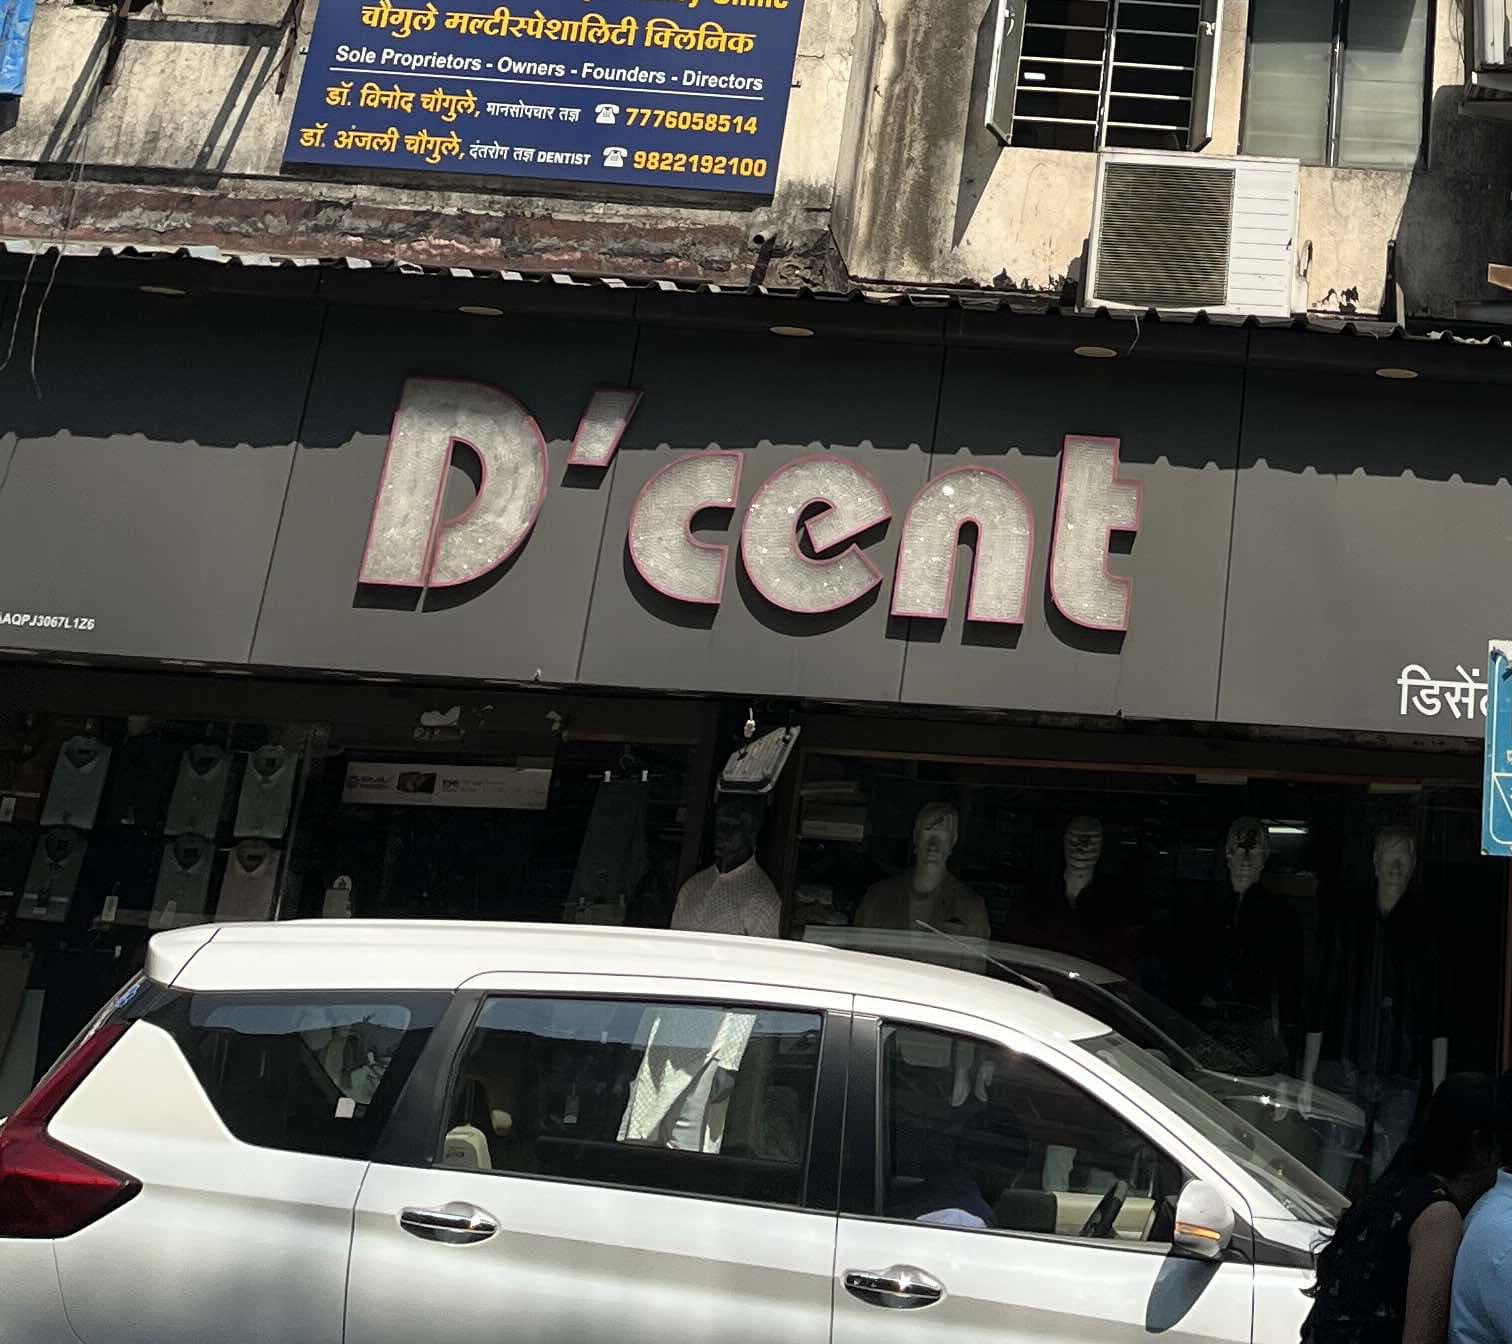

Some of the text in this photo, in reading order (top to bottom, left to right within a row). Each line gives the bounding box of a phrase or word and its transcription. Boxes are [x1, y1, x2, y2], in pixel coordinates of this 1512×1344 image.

[362, 0, 756, 53] चौगुले मल्टीस्पेशालिटी क्लिनिक
[336, 46, 763, 90] Sole Proprietors Owners Founders Directors
[326, 81, 415, 113] डॉ. विनोद
[626, 108, 757, 134] 7776058514
[300, 123, 400, 152] डॉ. अंजली
[537, 151, 766, 176] DENTIST 9822192100
[358, 377, 1143, 633] D'cent
